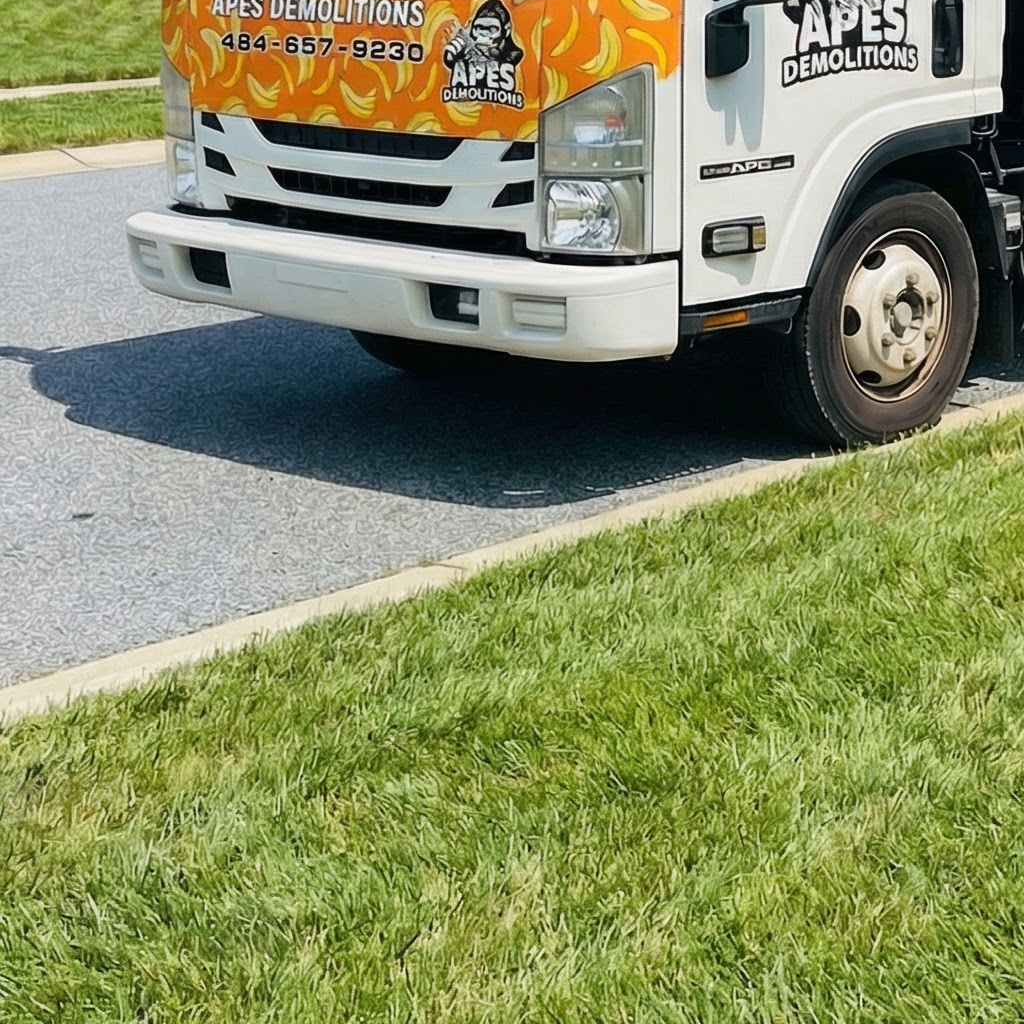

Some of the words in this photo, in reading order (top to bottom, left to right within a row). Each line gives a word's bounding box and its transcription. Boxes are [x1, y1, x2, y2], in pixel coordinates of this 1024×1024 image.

[220, 32, 425, 63] 484-657-9230
[451, 59, 515, 92] APES
[782, 44, 918, 85] DEMOLITIONS
